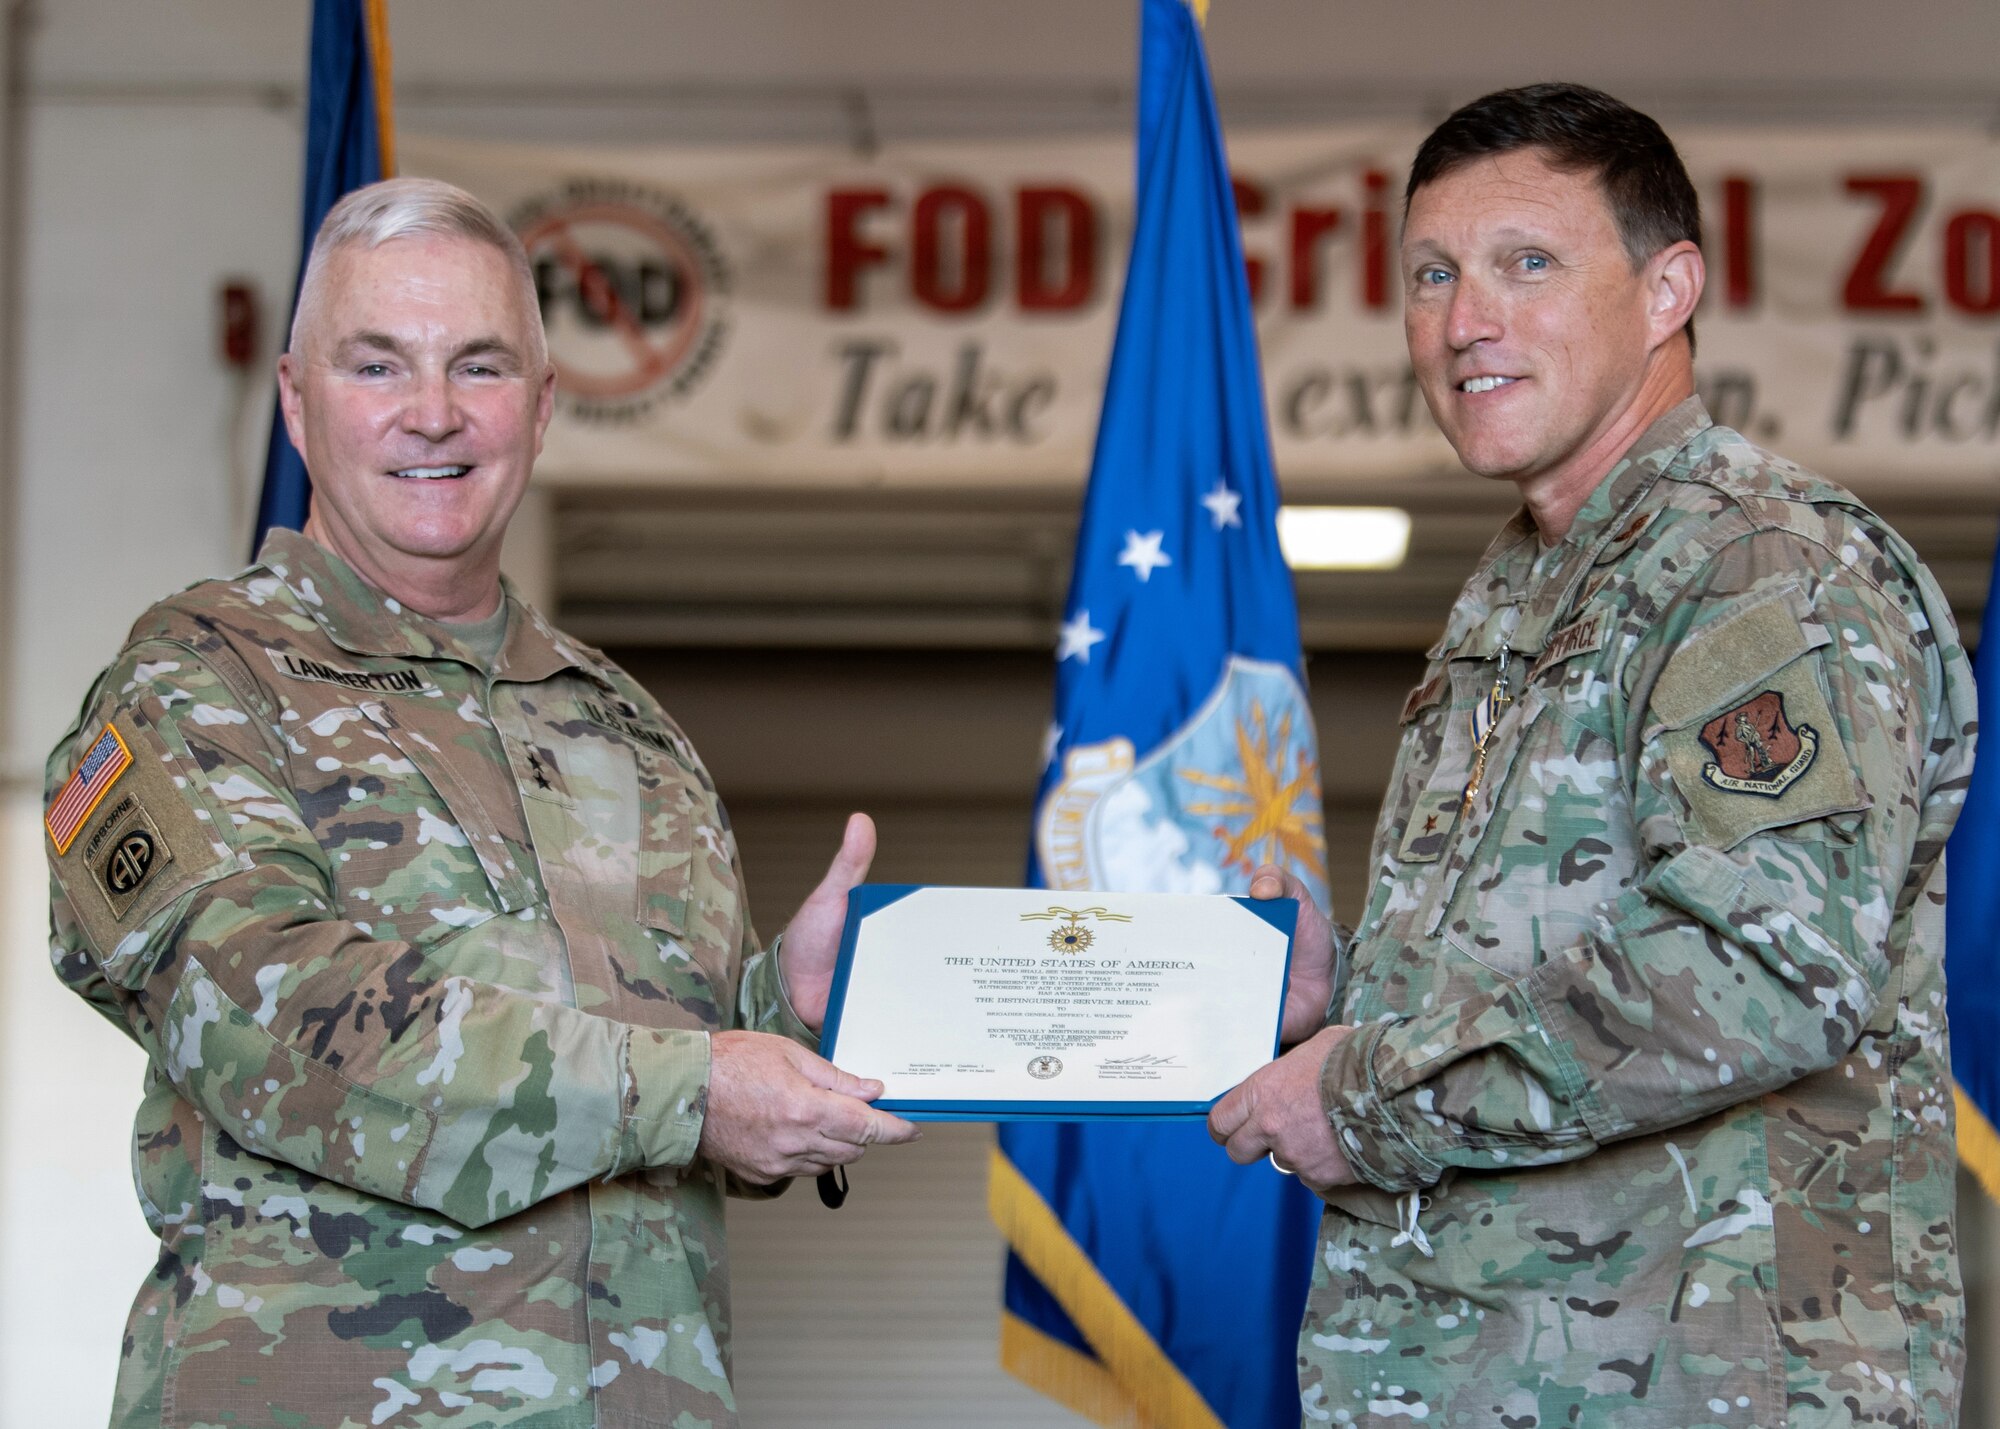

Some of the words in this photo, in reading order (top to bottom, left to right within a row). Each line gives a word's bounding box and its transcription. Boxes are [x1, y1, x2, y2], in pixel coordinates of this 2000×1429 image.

[824, 184, 1098, 313] FOD
[830, 338, 1059, 443] Take
[1833, 336, 2000, 441] Pic
[283, 655, 423, 691] LAMBERTON
[1720, 778, 1739, 787] AIR
[1744, 774, 1790, 792] NATIONAL
[1789, 749, 1812, 774] GUARD
[944, 957, 974, 966] THE
[979, 957, 1036, 968] UNITED
[1040, 959, 1096, 969] STATES
[1100, 960, 1121, 969] OF
[1126, 960, 1195, 970] AMERICA
